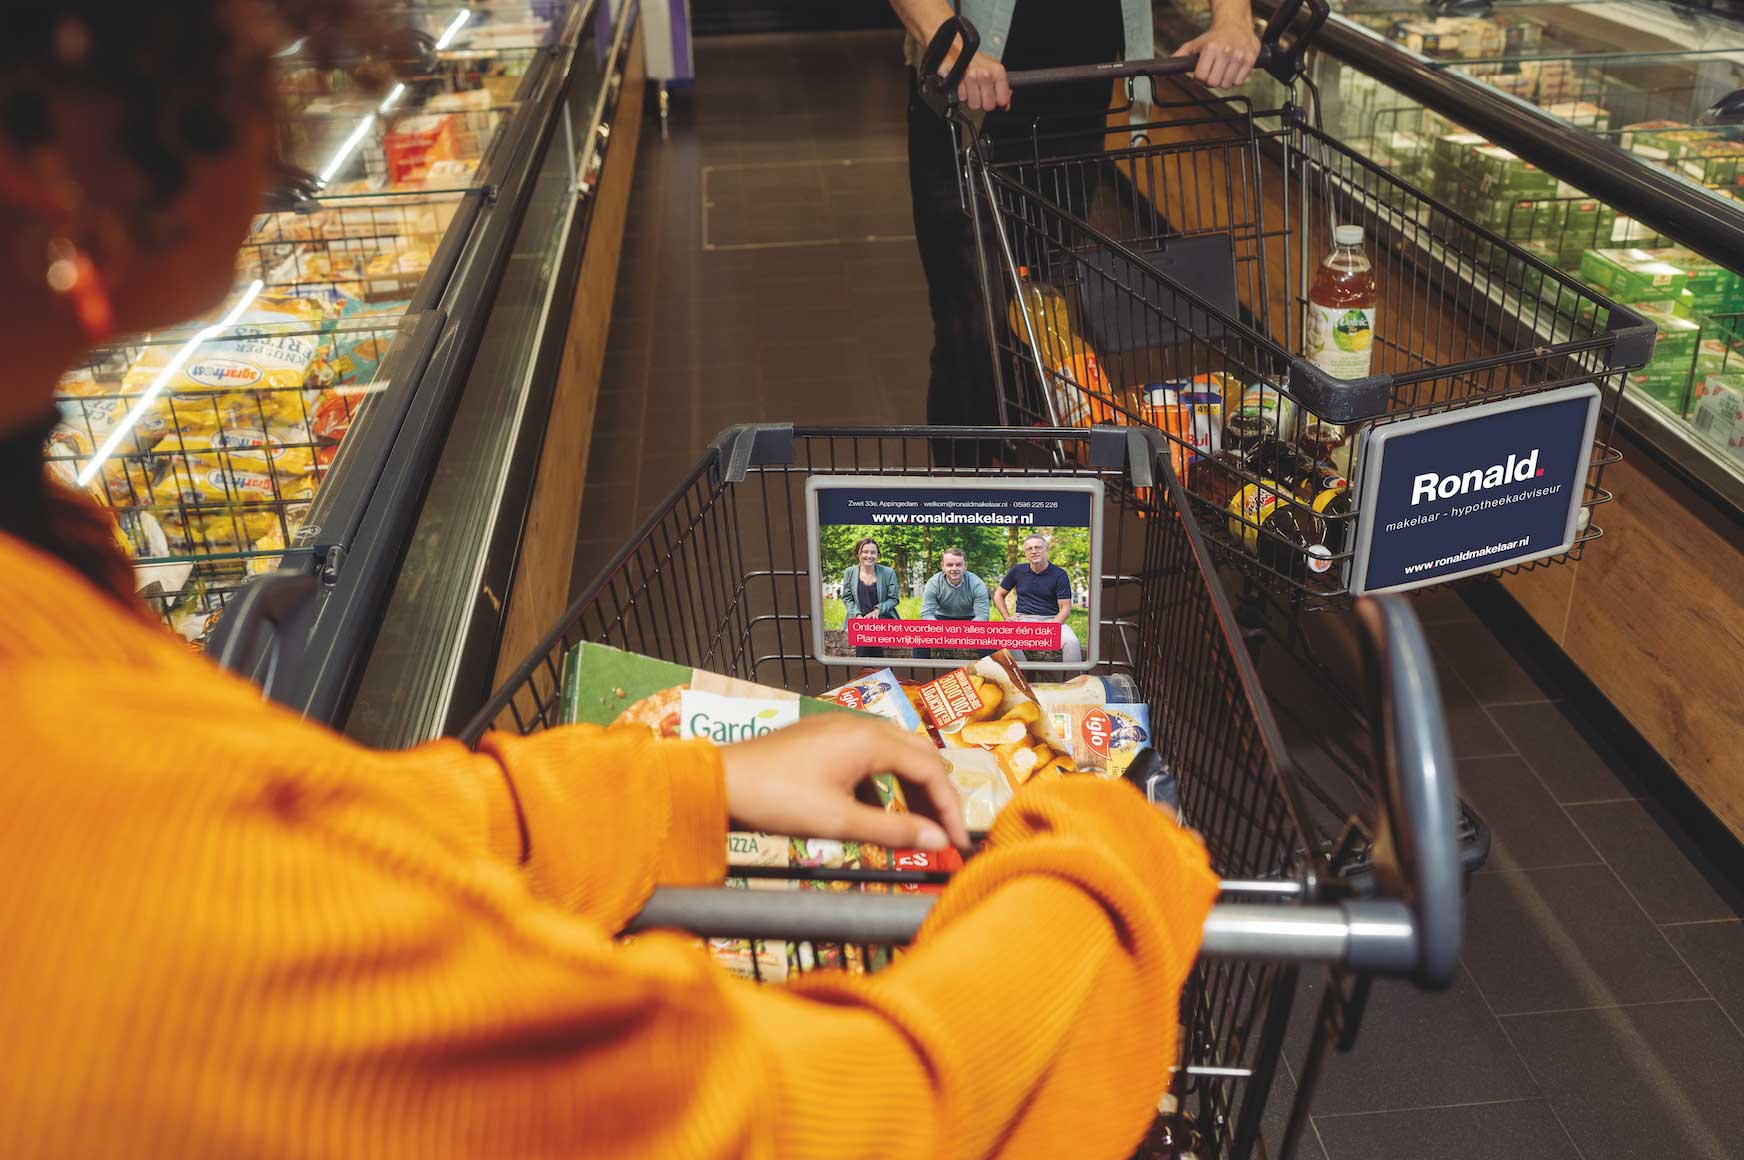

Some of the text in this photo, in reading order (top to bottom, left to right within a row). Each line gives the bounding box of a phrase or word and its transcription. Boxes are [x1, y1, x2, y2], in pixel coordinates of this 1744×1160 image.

[1411, 449, 1545, 506] Ronald.
[923, 500, 1008, 508] welkom@ronaldmakelaar.nl
[1385, 511, 1441, 532] makelaar
[1451, 483, 1562, 518] hypotheekadviseur
[872, 512, 1034, 524] www.ronaldmakelaar.nl
[1404, 536, 1530, 575] www.ronaldmakelaar.nl
[852, 622, 887, 632] Ontdek
[888, 623, 902, 632] het
[904, 624, 944, 633] voordeel
[945, 625, 961, 633] van
[986, 626, 1014, 635] onder
[1015, 626, 1033, 635] één
[856, 633, 1053, 648] Plan een vrijblijvend kennismakingsgesprek!
[839, 689, 858, 708] iglo
[921, 685, 947, 718] JACKPOT
[939, 674, 972, 717] 200.000€
[1086, 716, 1107, 747] iglo
[727, 836, 759, 854] IZZA
